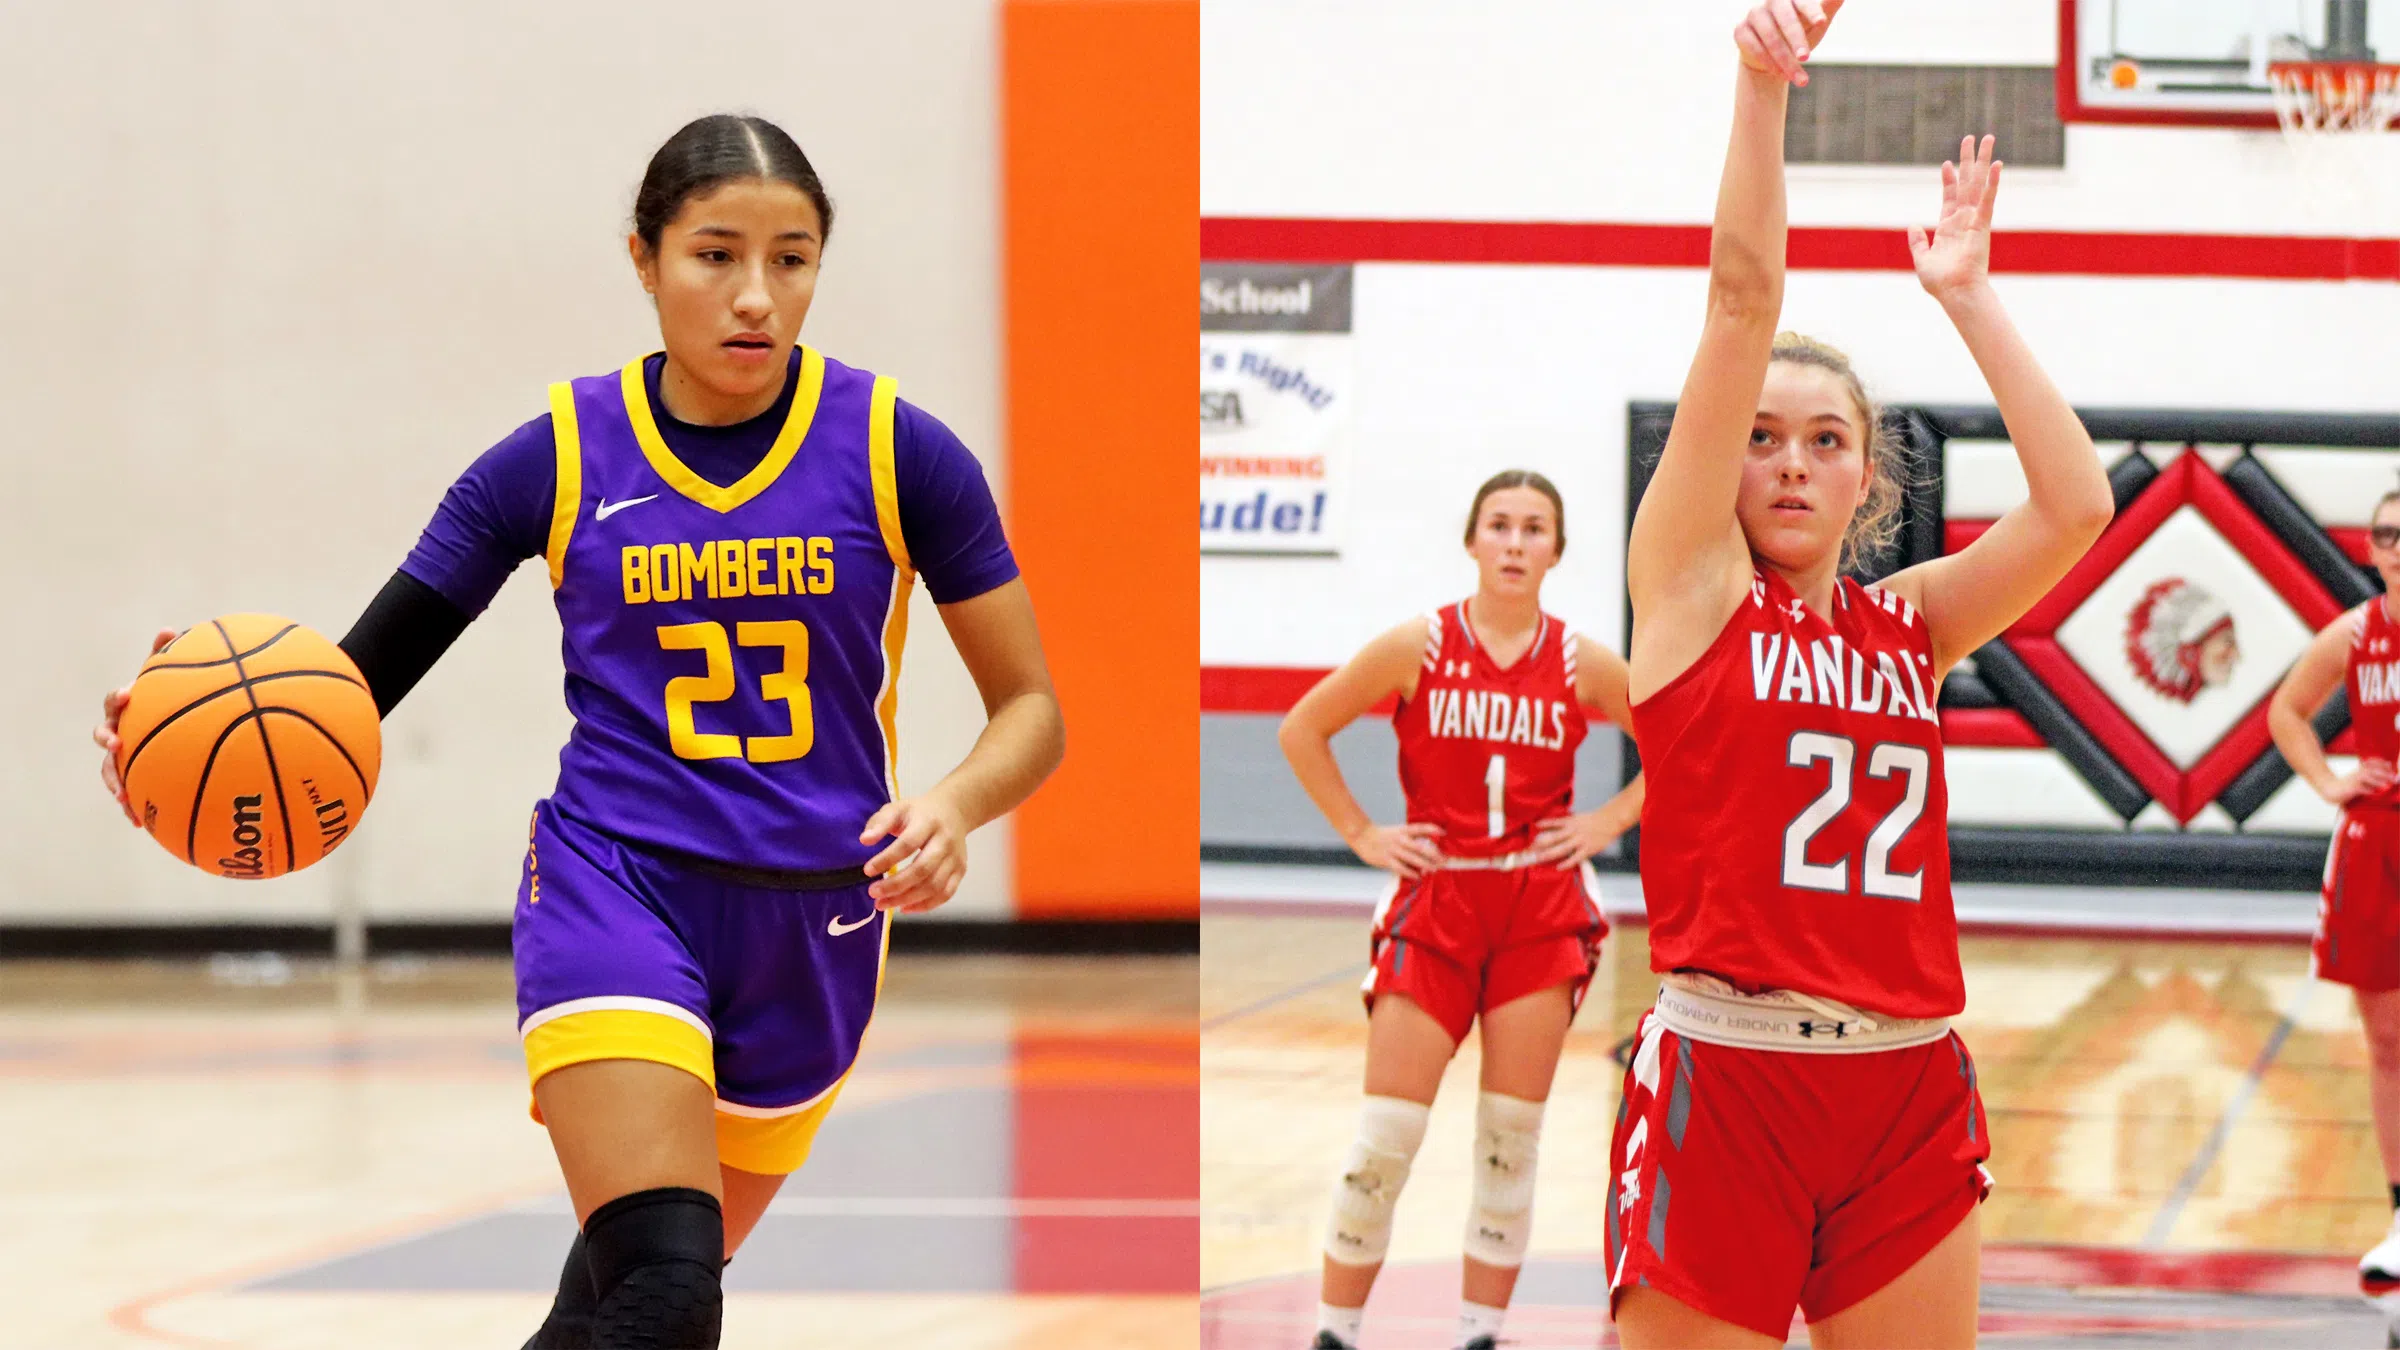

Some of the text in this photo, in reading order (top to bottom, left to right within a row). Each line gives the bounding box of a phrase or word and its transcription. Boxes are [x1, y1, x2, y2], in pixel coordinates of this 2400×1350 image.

[1200, 279, 1312, 315] School
[621, 535, 835, 605] BOMBERS
[655, 618, 815, 764] 23
[1428, 687, 1568, 752] VANDALS
[218, 792, 264, 880] ilson
[1483, 753, 1507, 839] 1
[1779, 728, 1931, 904] 22
